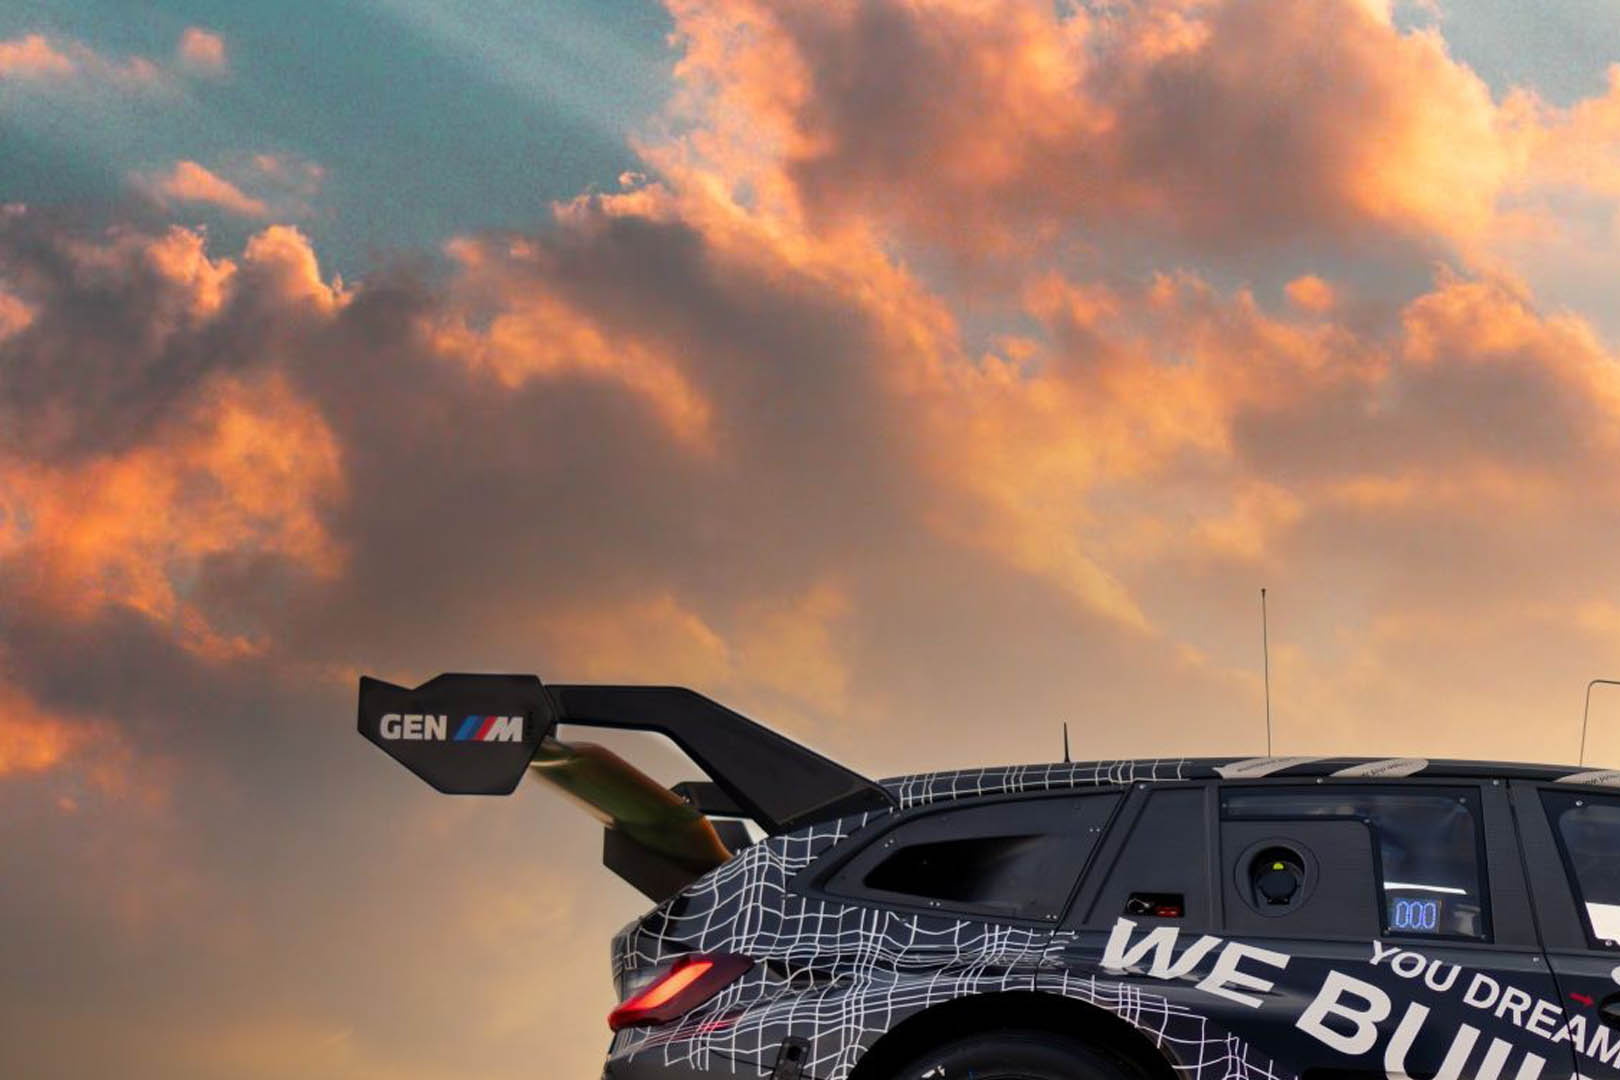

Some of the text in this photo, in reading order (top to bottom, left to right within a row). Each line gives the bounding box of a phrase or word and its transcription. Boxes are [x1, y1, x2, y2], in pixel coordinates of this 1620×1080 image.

[378, 713, 524, 742] GEN M
[1099, 917, 1291, 1009] WE
[1369, 940, 1463, 992] YOU
